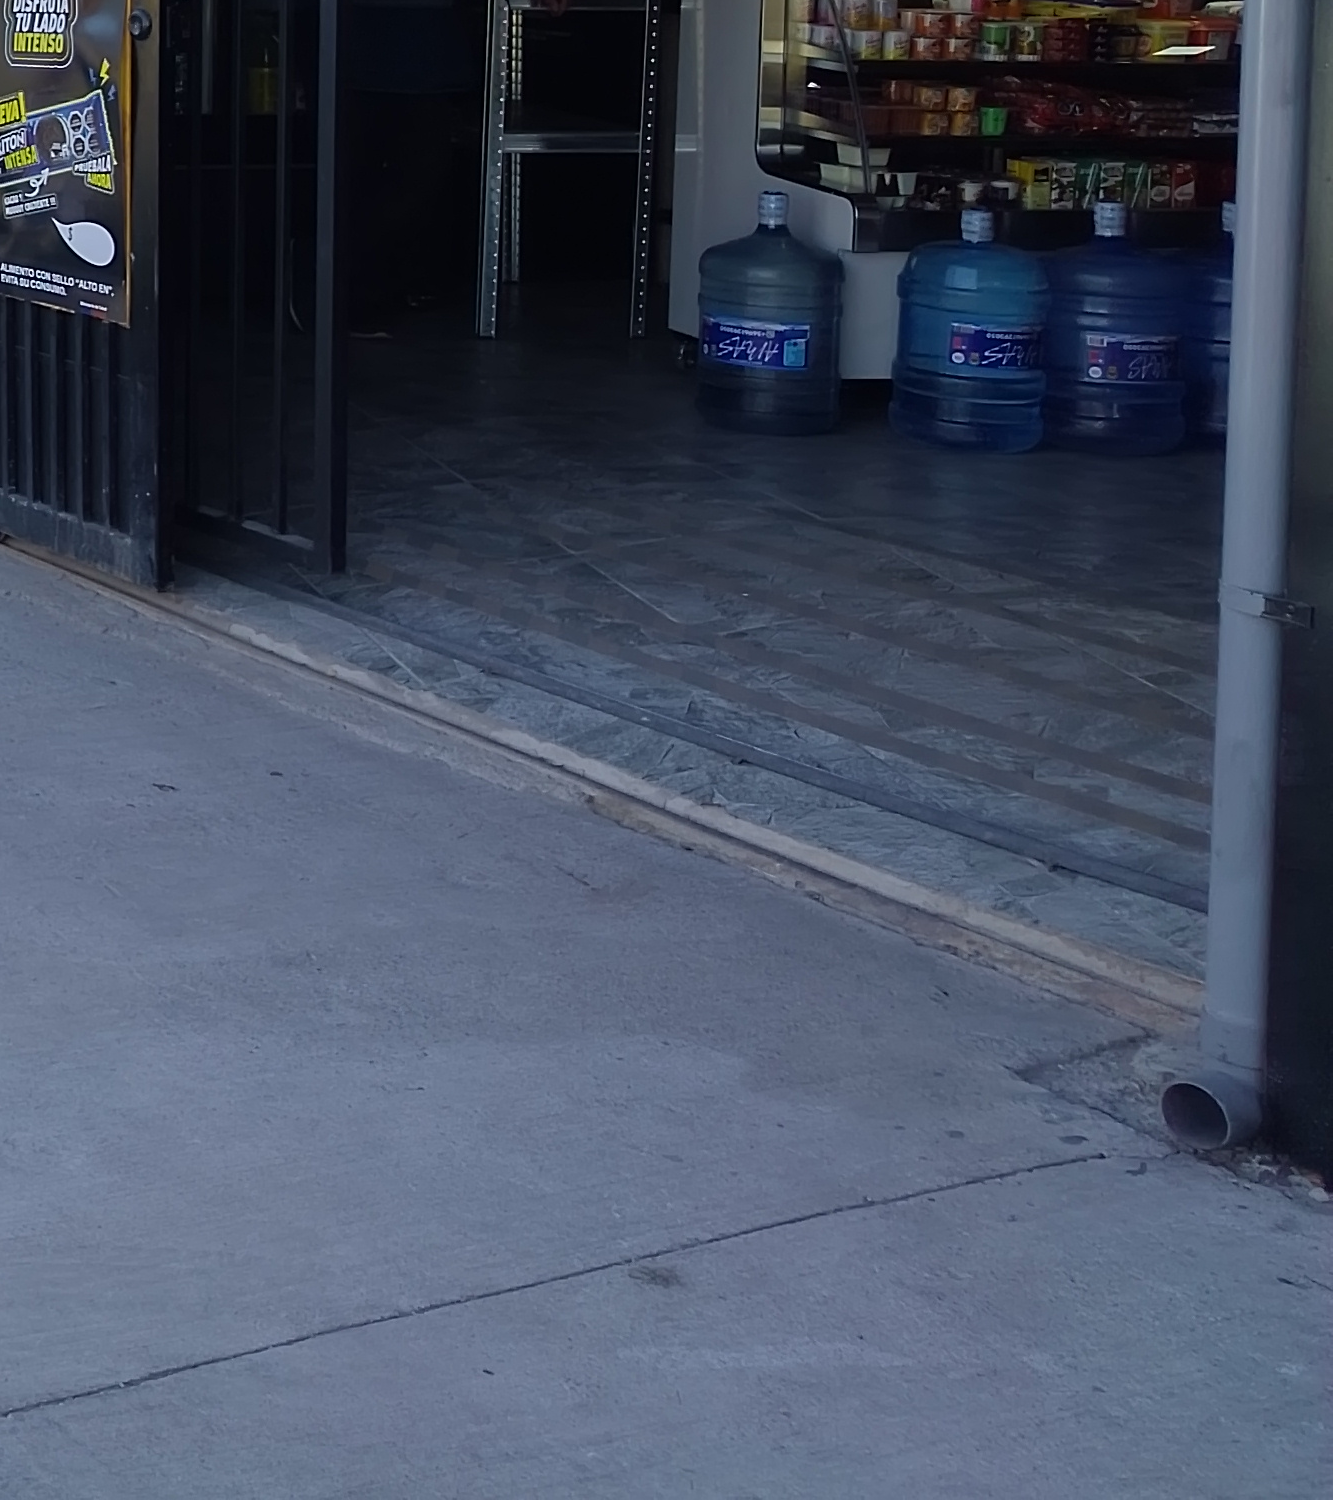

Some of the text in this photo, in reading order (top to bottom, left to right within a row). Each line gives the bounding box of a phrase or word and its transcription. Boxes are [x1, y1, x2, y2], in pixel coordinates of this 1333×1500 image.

[15, 13, 66, 33] TU LADO
[13, 33, 64, 53] INTENSO
[4, 145, 38, 170] INTENSA
[0, 262, 35, 277] ALIMENTO
[35, 270, 51, 280] CON
[51, 273, 75, 286] SELLO
[0, 273, 19, 286] EVITA
[19, 278, 30, 288] SU
